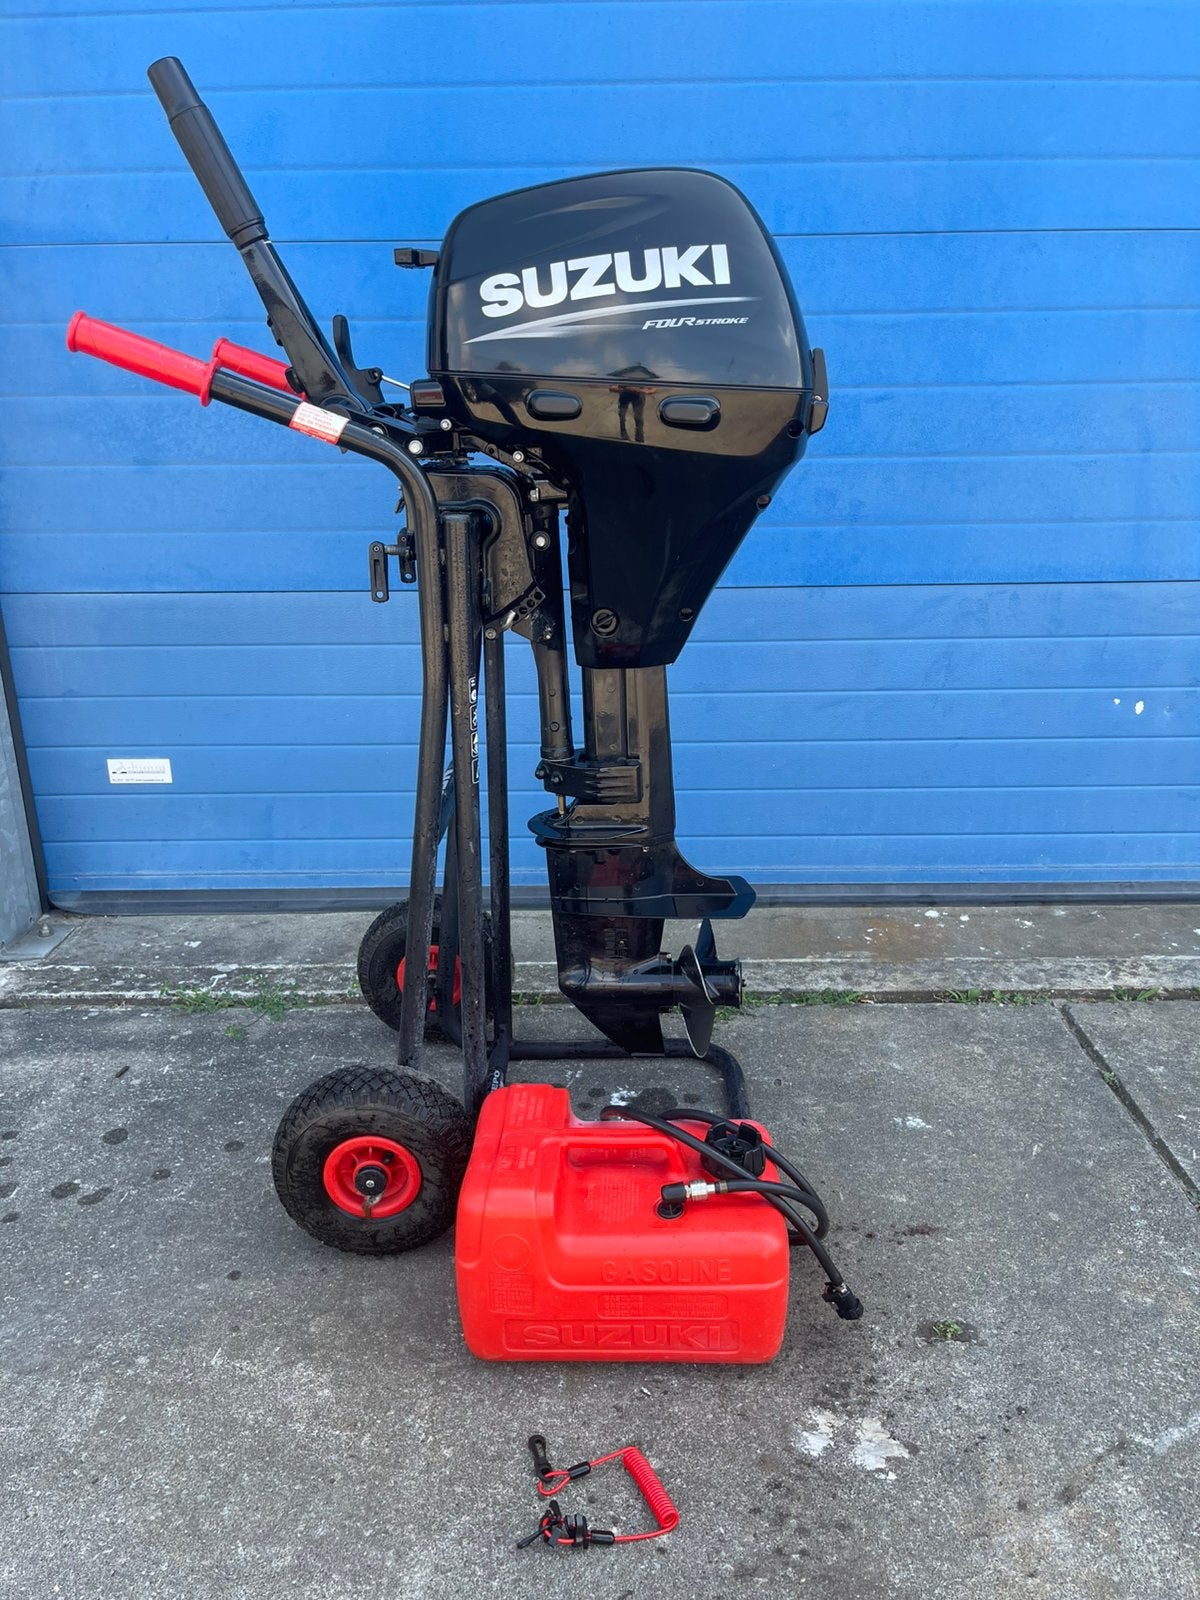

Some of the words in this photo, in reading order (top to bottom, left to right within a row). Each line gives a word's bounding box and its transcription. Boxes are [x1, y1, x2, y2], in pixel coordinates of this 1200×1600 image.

[480, 243, 731, 318] SUZUKI
[601, 1258, 732, 1283] GASOLINE
[524, 1324, 721, 1349] SUZUKI
